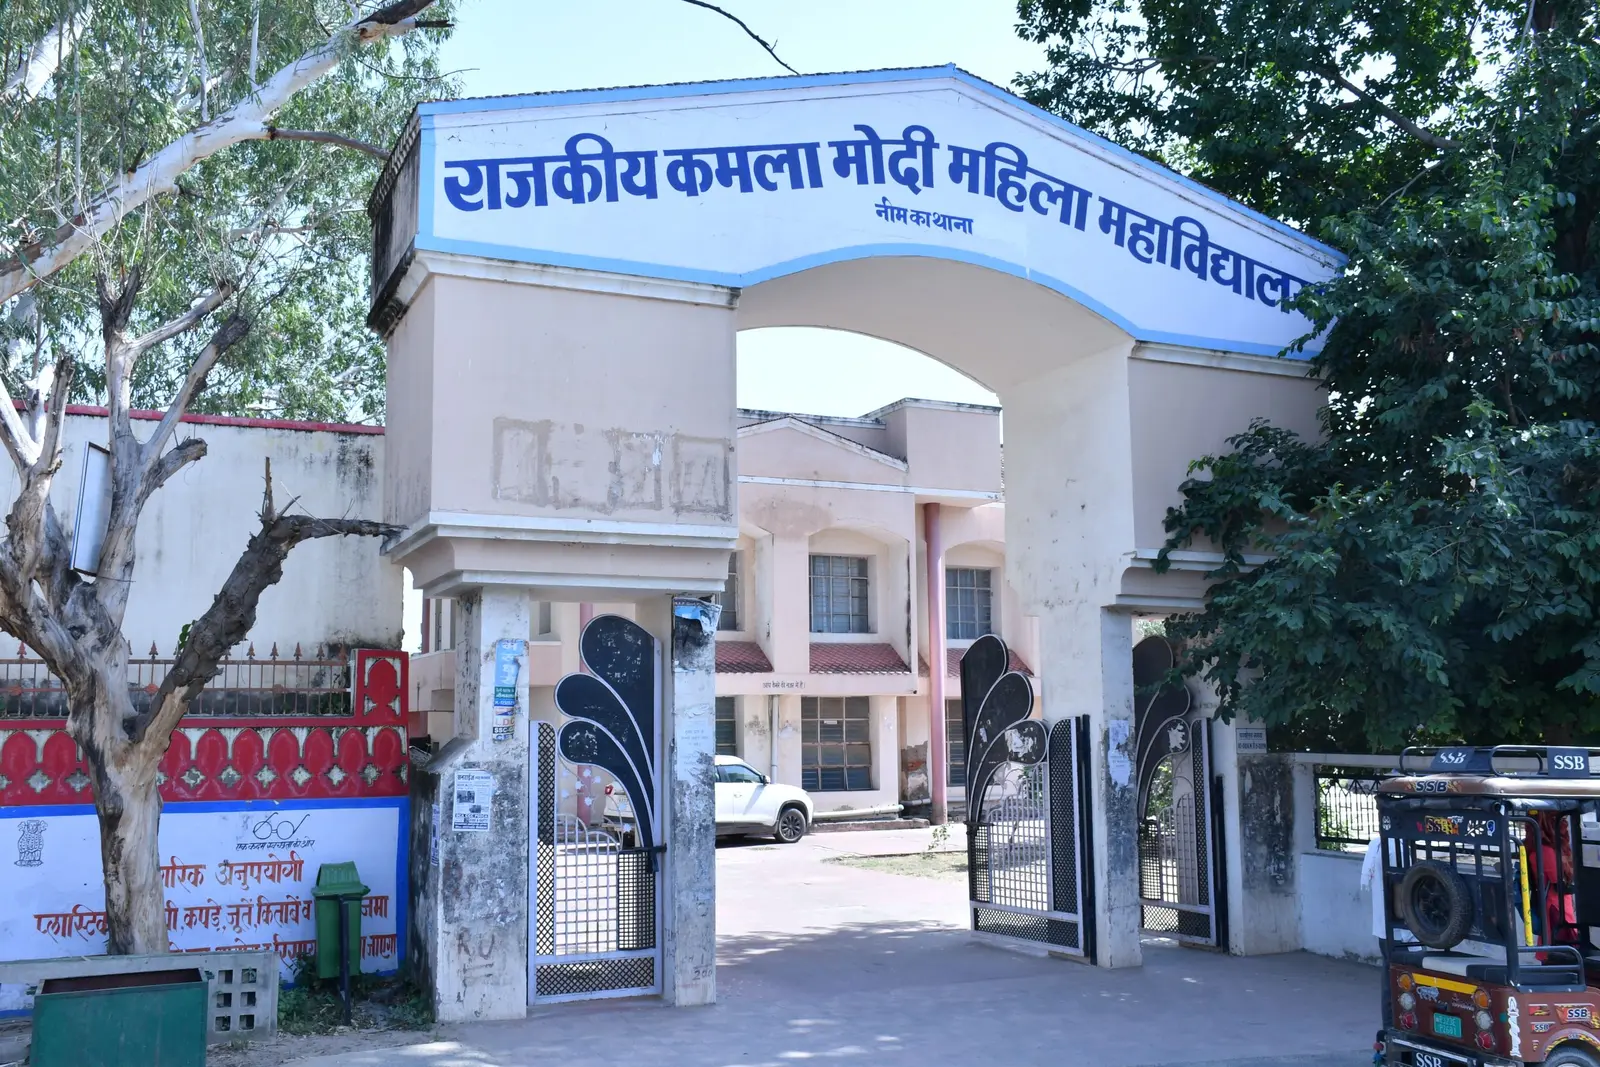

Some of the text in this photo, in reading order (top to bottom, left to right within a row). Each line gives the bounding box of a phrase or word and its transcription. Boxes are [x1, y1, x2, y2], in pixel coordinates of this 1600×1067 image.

[444, 132, 659, 212] राजकीय
[665, 141, 823, 198] कमला
[828, 123, 939, 195] मोदी
[947, 142, 1093, 232] महिला
[874, 195, 975, 236] नीम का थाना
[1439, 752, 1467, 764] SSB
[1554, 755, 1585, 770] SSB
[1415, 780, 1448, 793] SSB
[215, 850, 305, 891] अनुपयोगी
[1567, 1008, 1588, 1018] SSB
[1534, 1023, 1550, 1031] SSB
[1415, 1052, 1442, 1067] SSB
